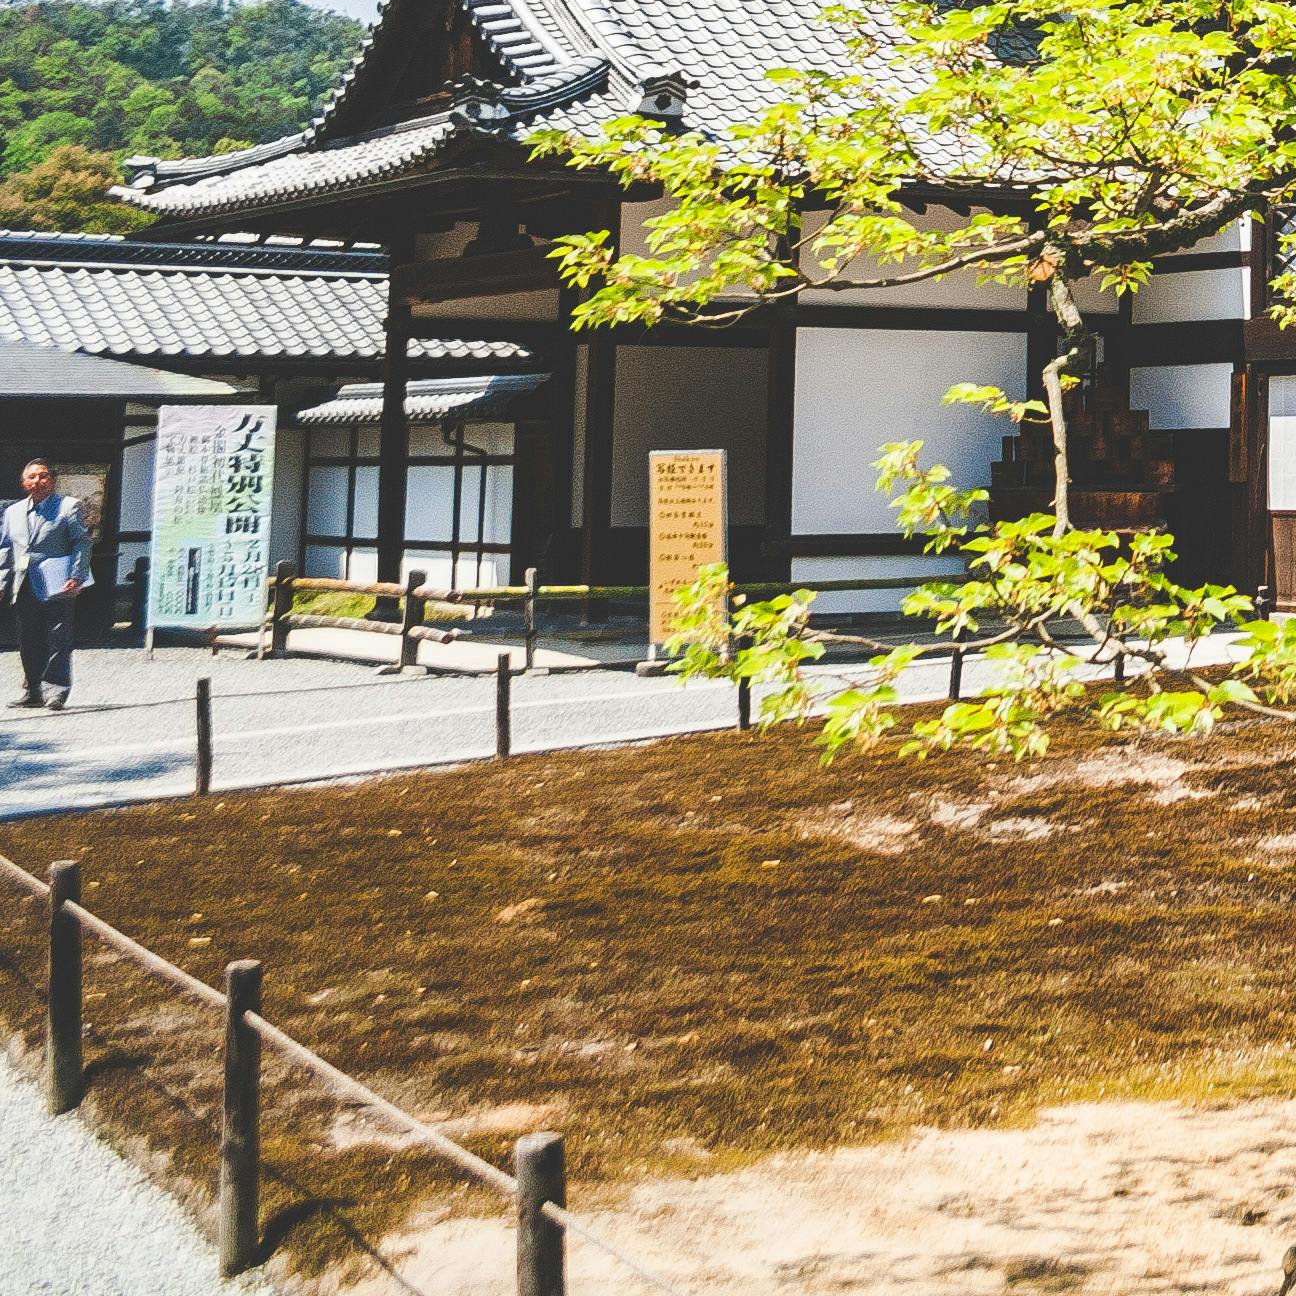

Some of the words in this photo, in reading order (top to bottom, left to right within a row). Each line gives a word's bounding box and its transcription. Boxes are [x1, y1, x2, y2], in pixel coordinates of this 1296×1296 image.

[226, 413, 266, 534] 方丈特別公開
